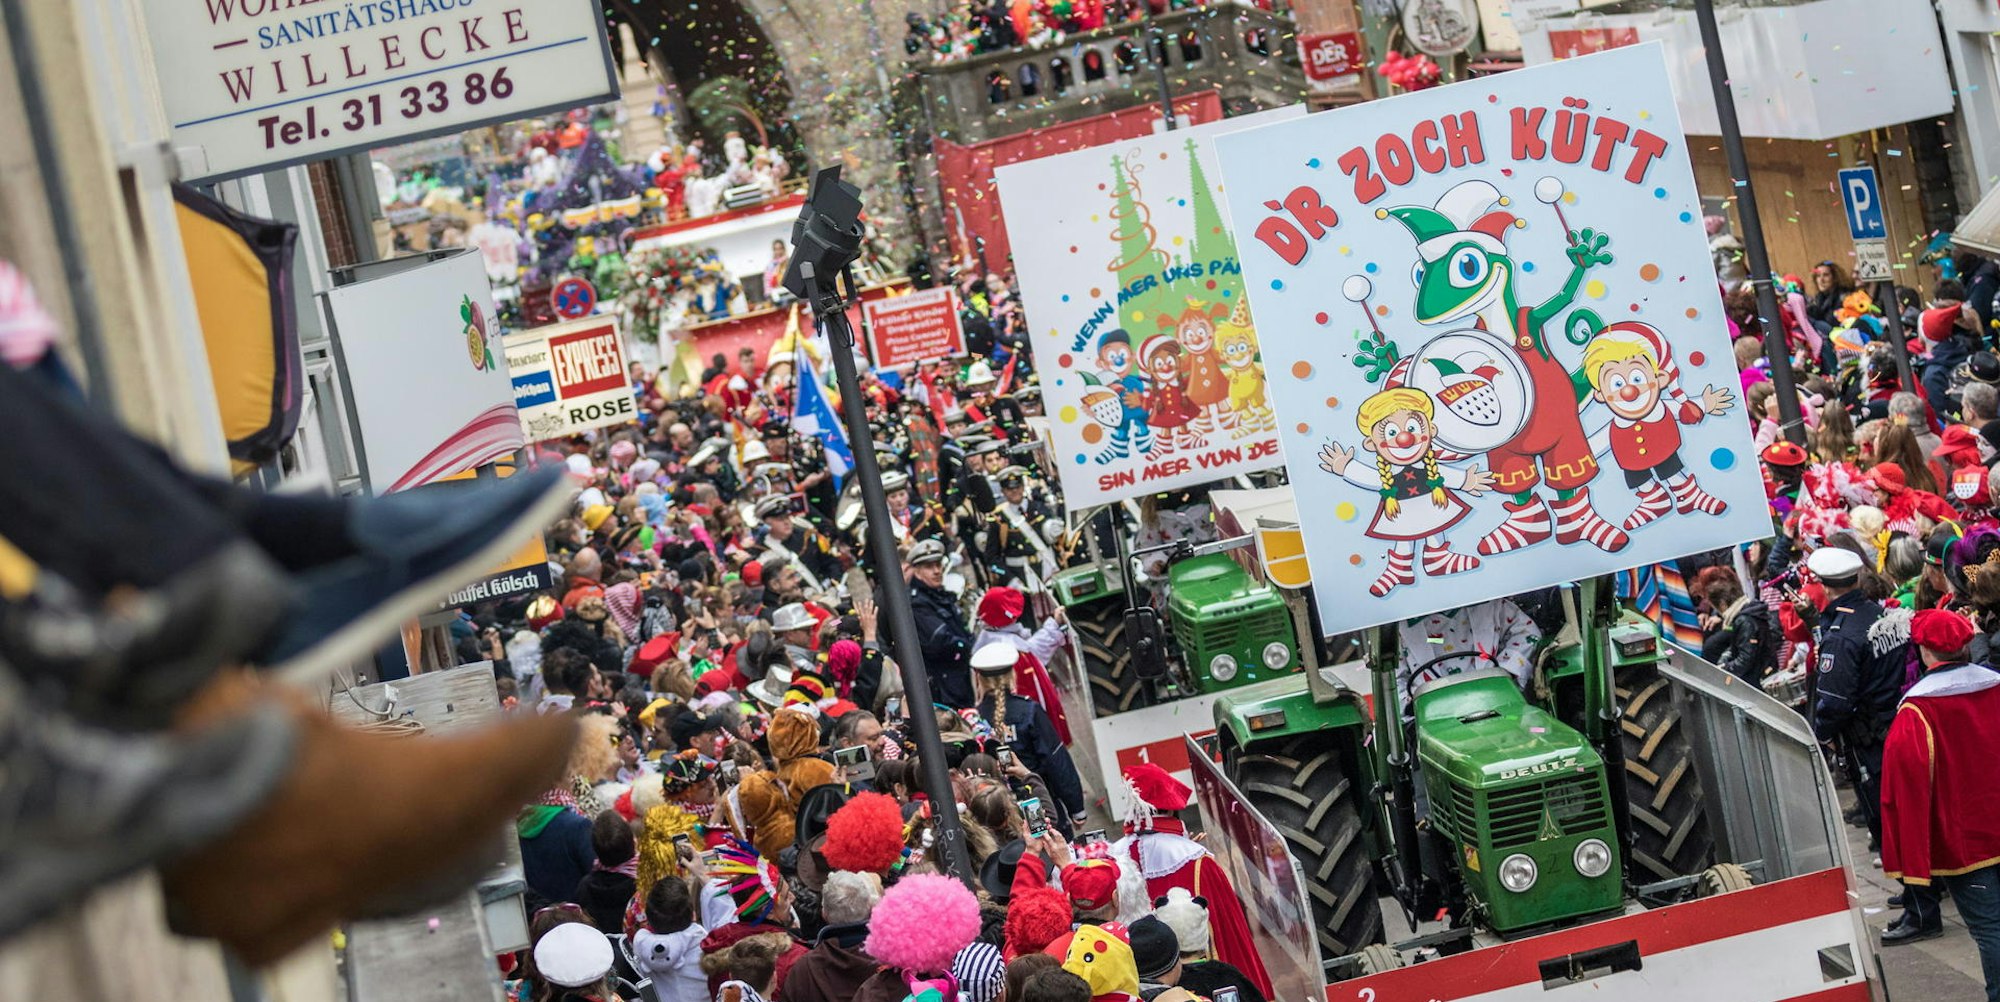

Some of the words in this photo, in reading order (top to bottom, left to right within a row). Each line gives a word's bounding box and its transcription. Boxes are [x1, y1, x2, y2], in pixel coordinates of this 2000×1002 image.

[257, 0, 472, 49] SANITÄTSHA
[219, 8, 529, 104] WILLECKE
[1311, 43, 1349, 66] DER
[257, 106, 330, 150] Tel.
[342, 94, 382, 132] 31
[400, 80, 449, 119] 33
[464, 66, 514, 105] 86
[1337, 110, 1486, 205] ZOCH
[1509, 96, 1669, 185] KÜTT
[1848, 178, 1871, 231] P
[1071, 301, 1115, 353] WENN
[1117, 274, 1158, 306] MER
[1162, 262, 1204, 285] UNS
[552, 333, 622, 388] EXPRESS
[569, 397, 633, 425] ROSE
[1098, 469, 1135, 492] SIN
[1142, 458, 1192, 481] MER
[1196, 447, 1242, 470] VUN
[1247, 439, 1279, 461] DE
[1872, 630, 1908, 659] POLIZ
[1138, 747, 1150, 764] 1
[1500, 757, 1577, 780] DEUTZ
